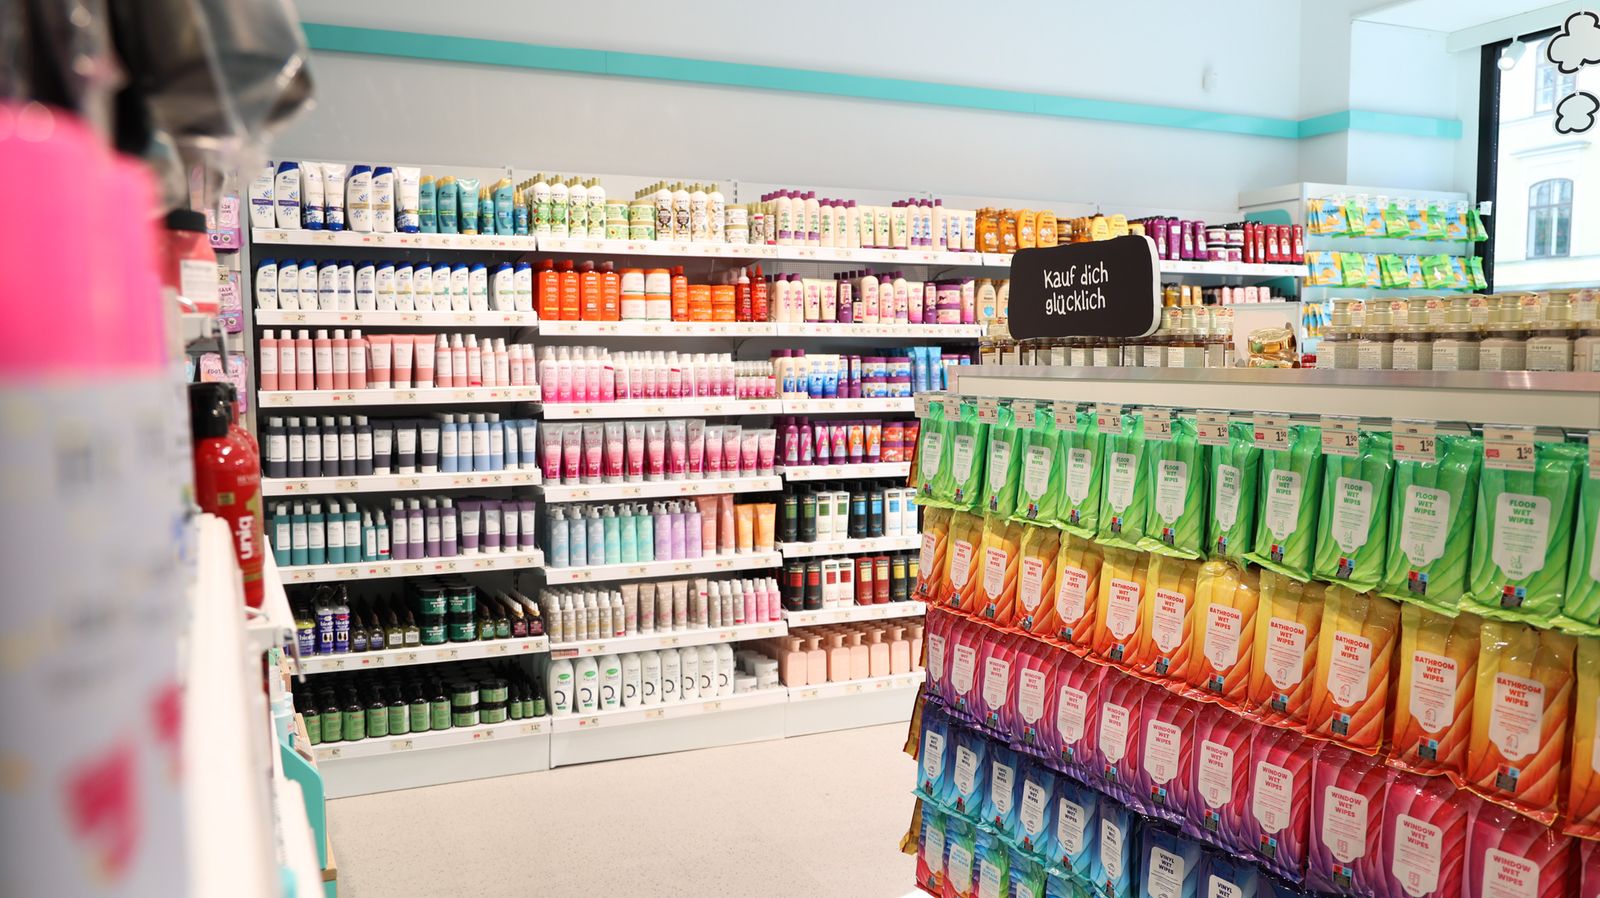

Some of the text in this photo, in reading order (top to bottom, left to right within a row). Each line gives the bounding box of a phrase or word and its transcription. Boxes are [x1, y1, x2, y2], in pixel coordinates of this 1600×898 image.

[1044, 261, 1109, 289] Kauf dich
[1045, 287, 1106, 315] glücklich
[1217, 428, 1227, 437] 1.50
[1276, 432, 1287, 442] 1.50
[1345, 436, 1358, 446] 1.50
[1420, 440, 1434, 452] 1.50
[1516, 447, 1532, 460] 1.50
[1223, 468, 1235, 477] FLOOR
[1224, 476, 1234, 484] WET
[1276, 474, 1293, 483] FLOOR
[1222, 482, 1234, 490] WIPES
[1278, 481, 1290, 489] WET
[1344, 483, 1363, 492] FLOOR
[1276, 487, 1292, 496] WIPES
[1346, 490, 1360, 499] WET
[1343, 497, 1362, 506] WIPES
[1416, 492, 1438, 502] FLOOR
[1418, 500, 1434, 509] WET
[1509, 499, 1537, 510] FLOOR
[1414, 507, 1436, 517] WIPES
[1513, 508, 1532, 517] WET
[1508, 516, 1534, 526] WIPES
[236, 515, 254, 560] uniq
[1112, 582, 1138, 592] BATHROOM
[1116, 594, 1130, 602] WIPES
[1157, 592, 1184, 604] BATHROOM
[1164, 600, 1175, 608] WET
[1162, 606, 1176, 614] WIPES
[1210, 607, 1240, 620] BATHROOM
[1218, 615, 1230, 624] WET
[1214, 621, 1232, 631] WIPES
[1270, 622, 1304, 636] BATHROOM
[1279, 630, 1292, 640] WET
[1276, 637, 1295, 647] WIPES
[1336, 635, 1370, 650] BATHROOM
[1344, 644, 1358, 654] WET
[1340, 650, 1360, 662] WIPES
[1414, 655, 1456, 671] BATHROOM
[1426, 664, 1442, 676] WET
[1422, 672, 1445, 684] WIPES
[1496, 677, 1542, 694] BATHROOM
[1508, 686, 1526, 698] WET
[1504, 694, 1530, 708] WIPES
[1106, 706, 1126, 717] WINDOW
[1108, 718, 1122, 728] WIPES
[1152, 724, 1177, 736] WINDOW
[1158, 731, 1170, 739] WET
[1156, 736, 1172, 746] WIPES
[1206, 745, 1229, 758] WINDOW
[1210, 752, 1222, 761] WET
[1208, 758, 1224, 768] WIPES
[1262, 766, 1288, 780] WINDOW
[1268, 775, 1281, 784] WET
[1264, 781, 1282, 792] WIPES
[1331, 791, 1362, 806] WINDOW
[1338, 800, 1352, 810] WET
[1334, 806, 1356, 818] WIPES
[1403, 820, 1436, 838] WINDOW
[1410, 830, 1426, 842] WET
[1407, 836, 1430, 850] WIPES
[1159, 852, 1174, 864] VINYL
[1161, 860, 1172, 869] WET
[1492, 854, 1532, 874] WINDOW
[1158, 864, 1174, 876] WIPES
[1502, 865, 1520, 878] WET
[1498, 872, 1524, 887] WIPES
[1217, 882, 1233, 894] VINYL
